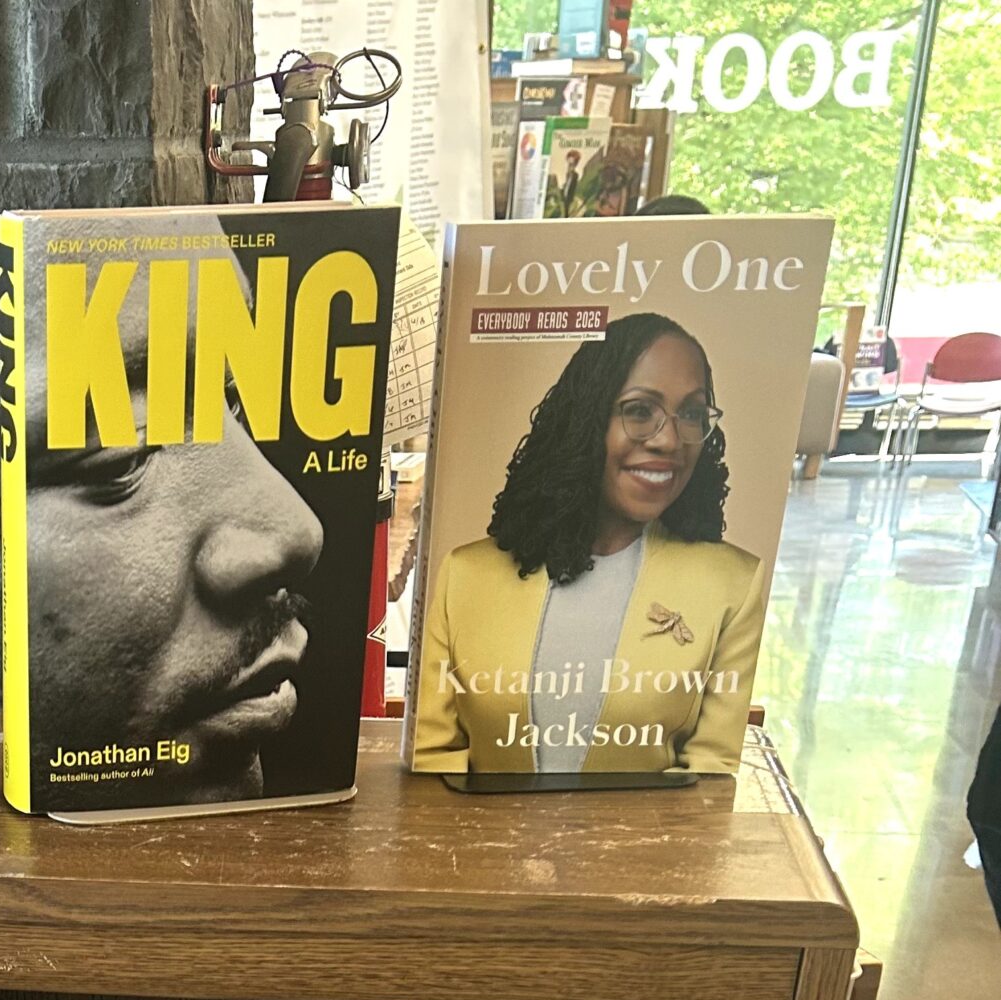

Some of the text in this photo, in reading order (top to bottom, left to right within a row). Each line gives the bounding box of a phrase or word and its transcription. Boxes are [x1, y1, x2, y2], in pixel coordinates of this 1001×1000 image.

[47, 234, 276, 254] NEW YORK TIMES BESTSELLER
[476, 240, 803, 302] Lovely One
[477, 311, 601, 330] EVERYBODY READS 2026
[45, 250, 379, 450] KING
[303, 449, 368, 473] A Life
[438, 659, 739, 699] Ketanji Brown
[496, 712, 666, 748] Jackson
[50, 741, 190, 767] Jonathan Eig
[50, 768, 154, 783] Bestselling author of Ali
